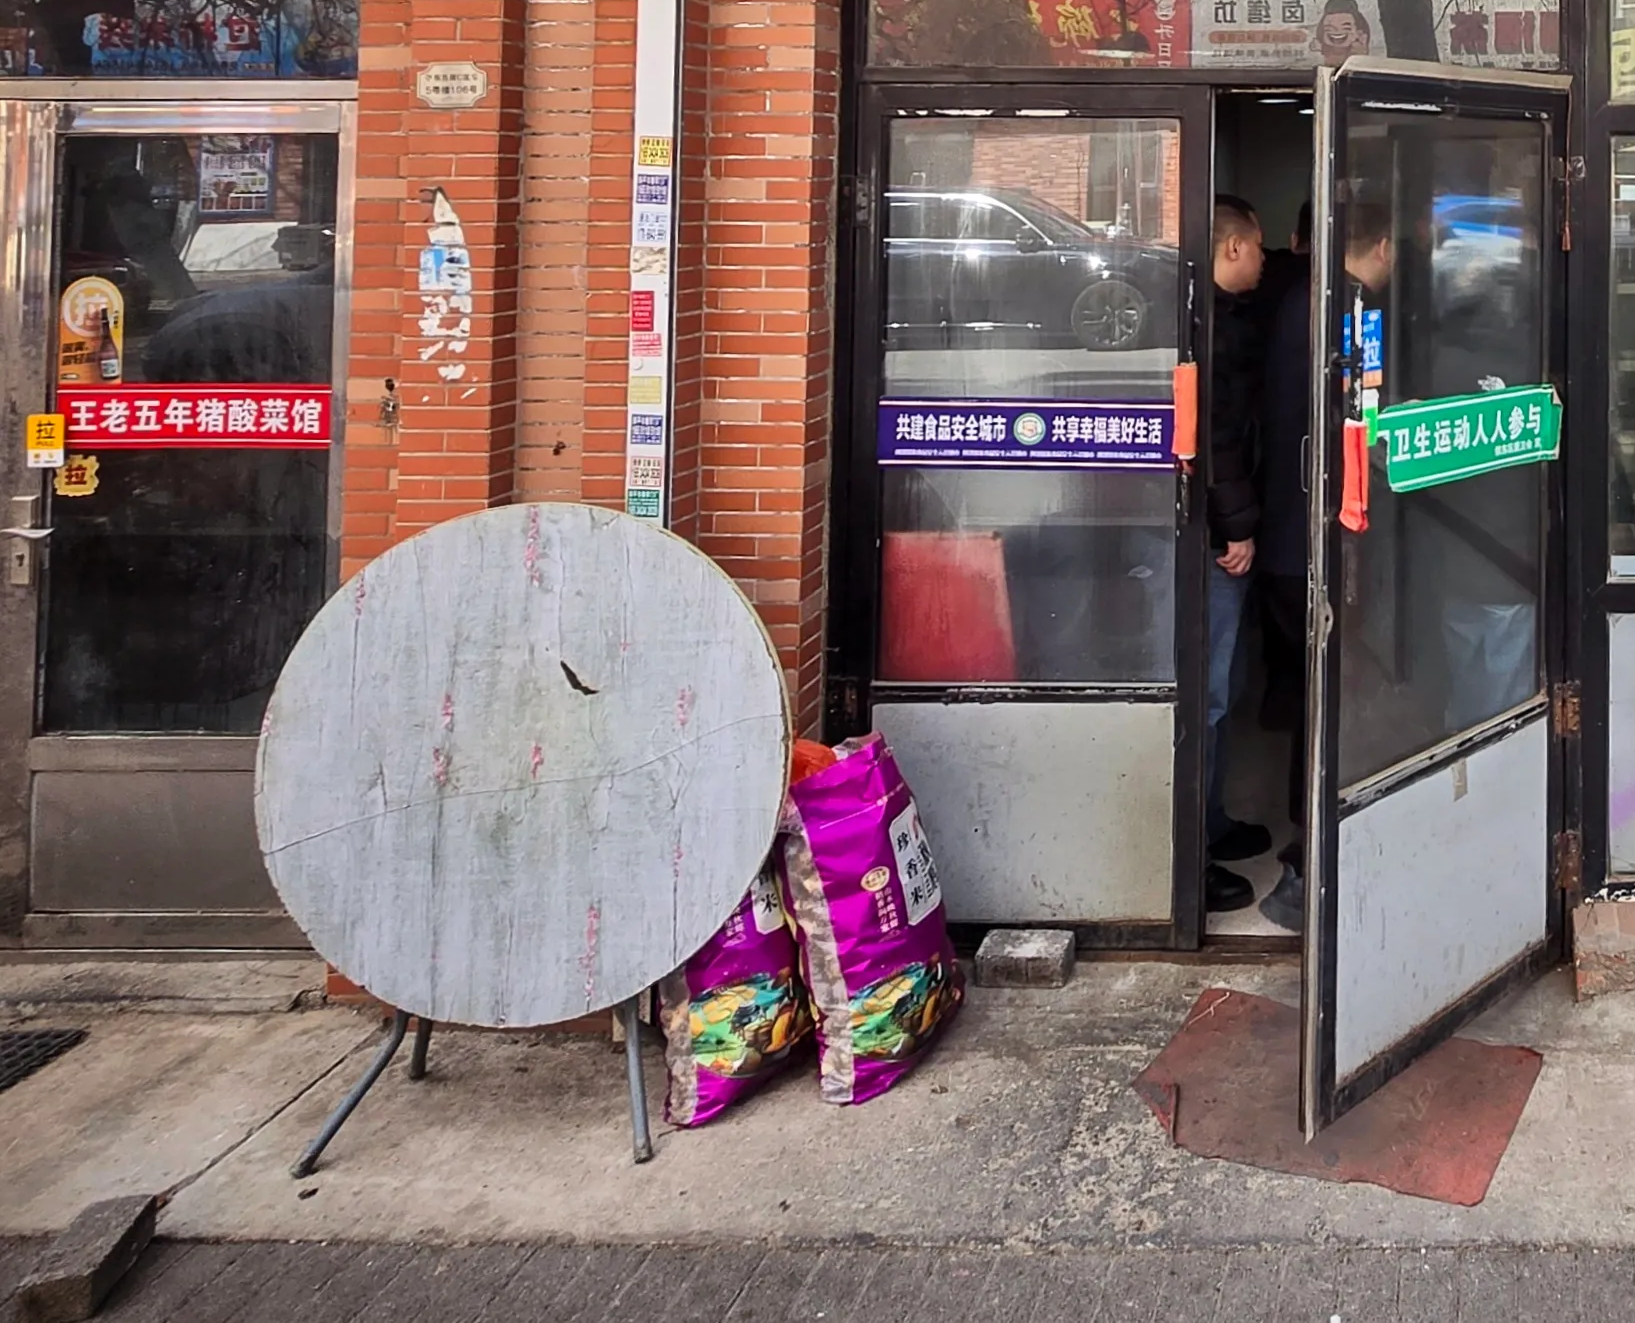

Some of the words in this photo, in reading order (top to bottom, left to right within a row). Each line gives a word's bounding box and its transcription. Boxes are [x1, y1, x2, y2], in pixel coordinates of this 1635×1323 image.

[36, 420, 55, 439] 拉
[68, 398, 322, 435] 王老五年猪酸菜馆
[896, 414, 1007, 442] 共建食品安全城市
[1052, 416, 1163, 445] 共享幸福美好生活
[1391, 403, 1542, 462] 卫生运动人人参与
